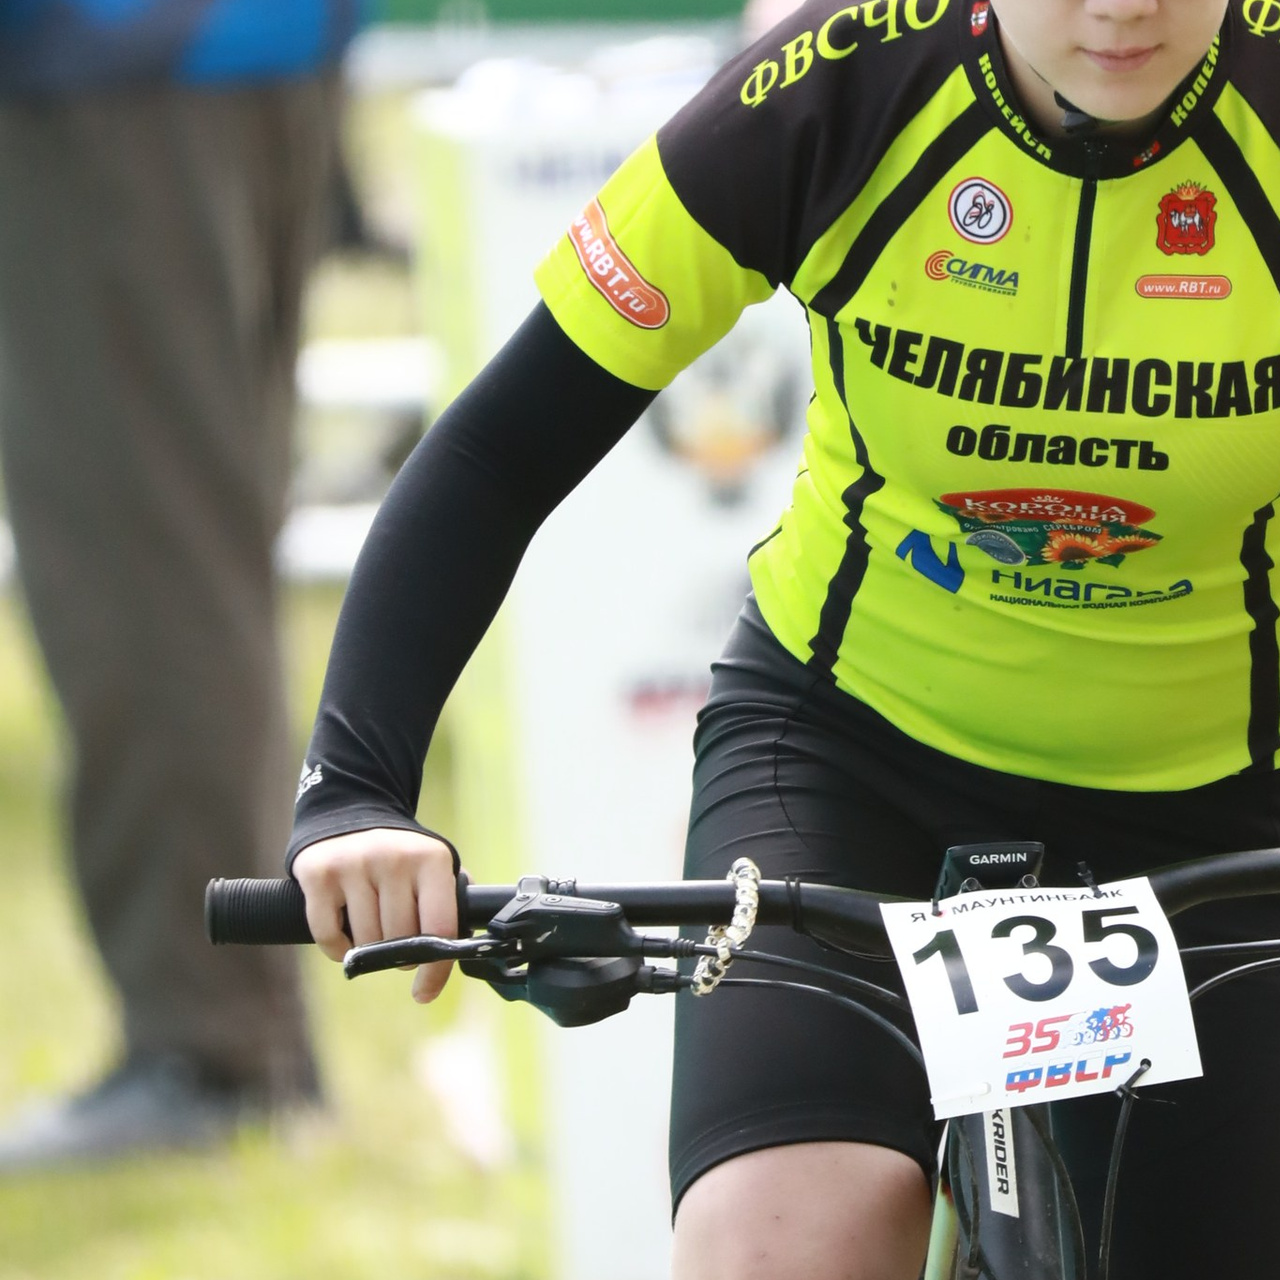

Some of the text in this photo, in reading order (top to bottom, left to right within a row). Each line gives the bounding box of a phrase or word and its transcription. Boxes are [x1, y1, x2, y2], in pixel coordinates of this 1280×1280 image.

[946, 258, 1019, 288] СИГМА
[1143, 280, 1222, 294] www.RBT.ru
[969, 852, 1028, 866] GARMIN
[910, 911, 927, 923] Я
[911, 905, 1159, 1017] 135
[1002, 1013, 1070, 1059] 35
[1004, 1045, 1132, 1094] ФВСР
